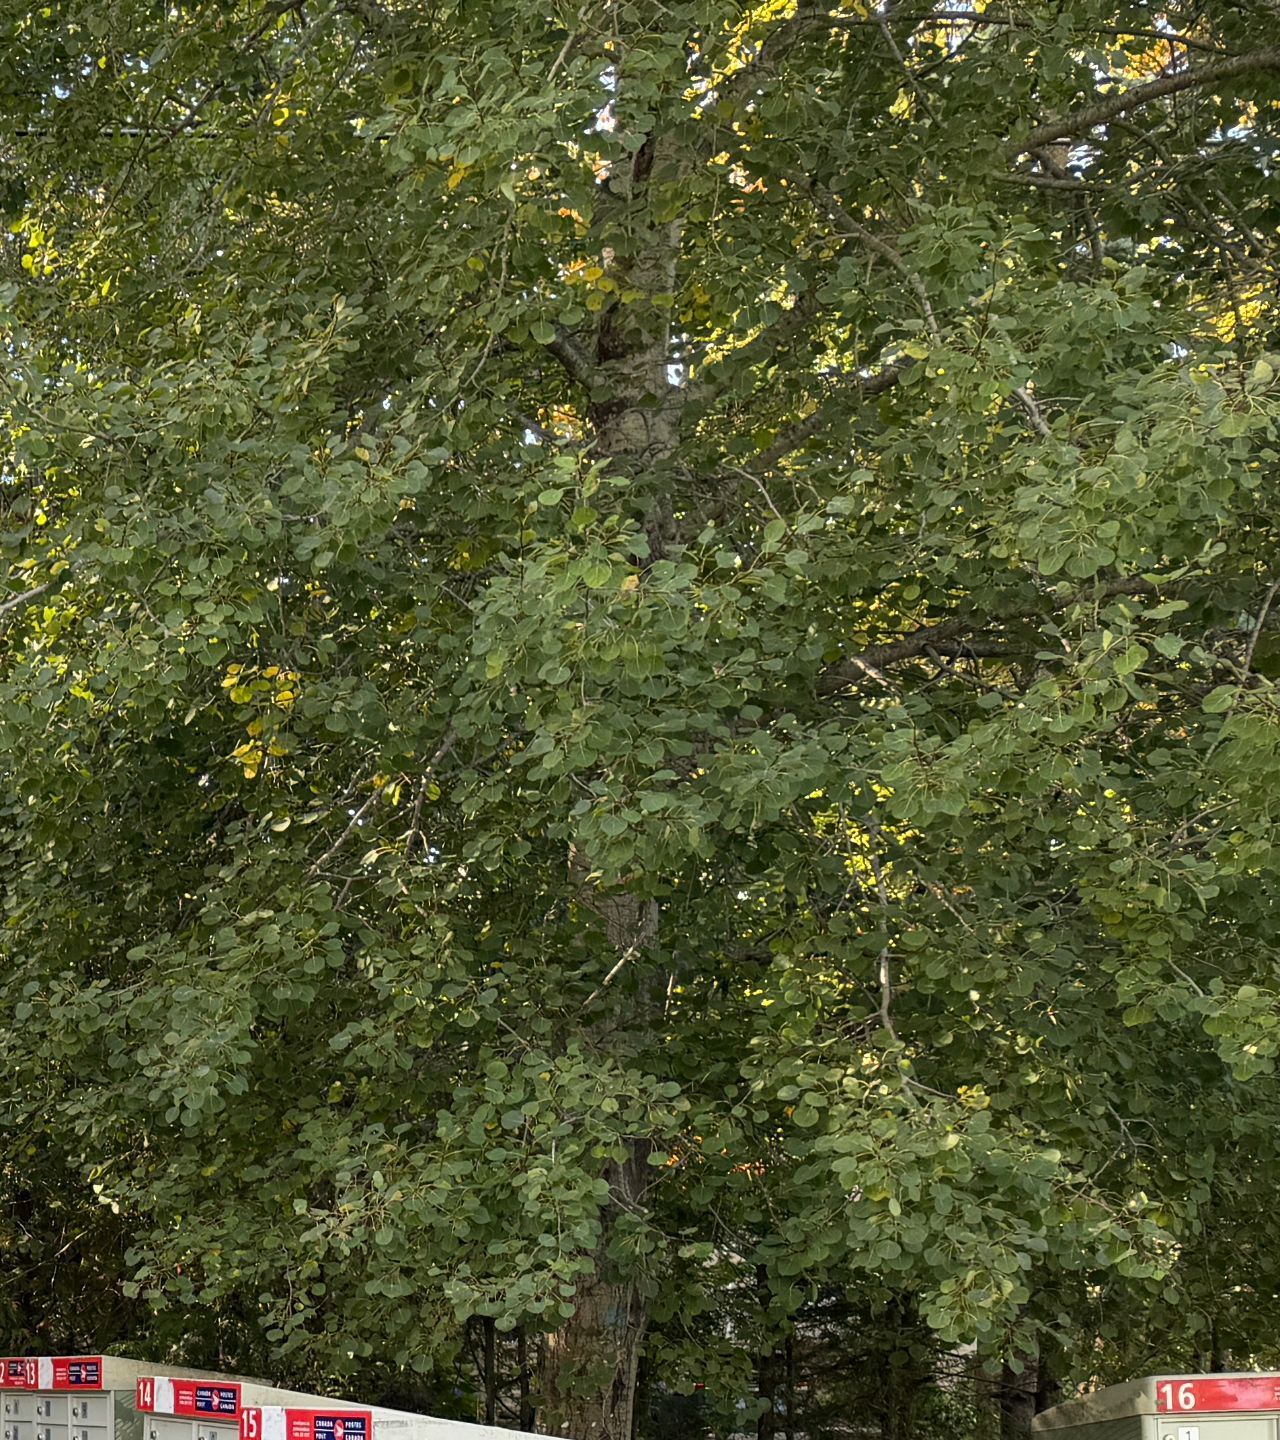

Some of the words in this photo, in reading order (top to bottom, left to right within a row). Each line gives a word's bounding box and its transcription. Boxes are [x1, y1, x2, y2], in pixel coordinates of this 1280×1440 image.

[26, 1362, 36, 1385] 13
[139, 1381, 152, 1407] 14
[1161, 1382, 1196, 1411] 16
[241, 1409, 258, 1438] 15
